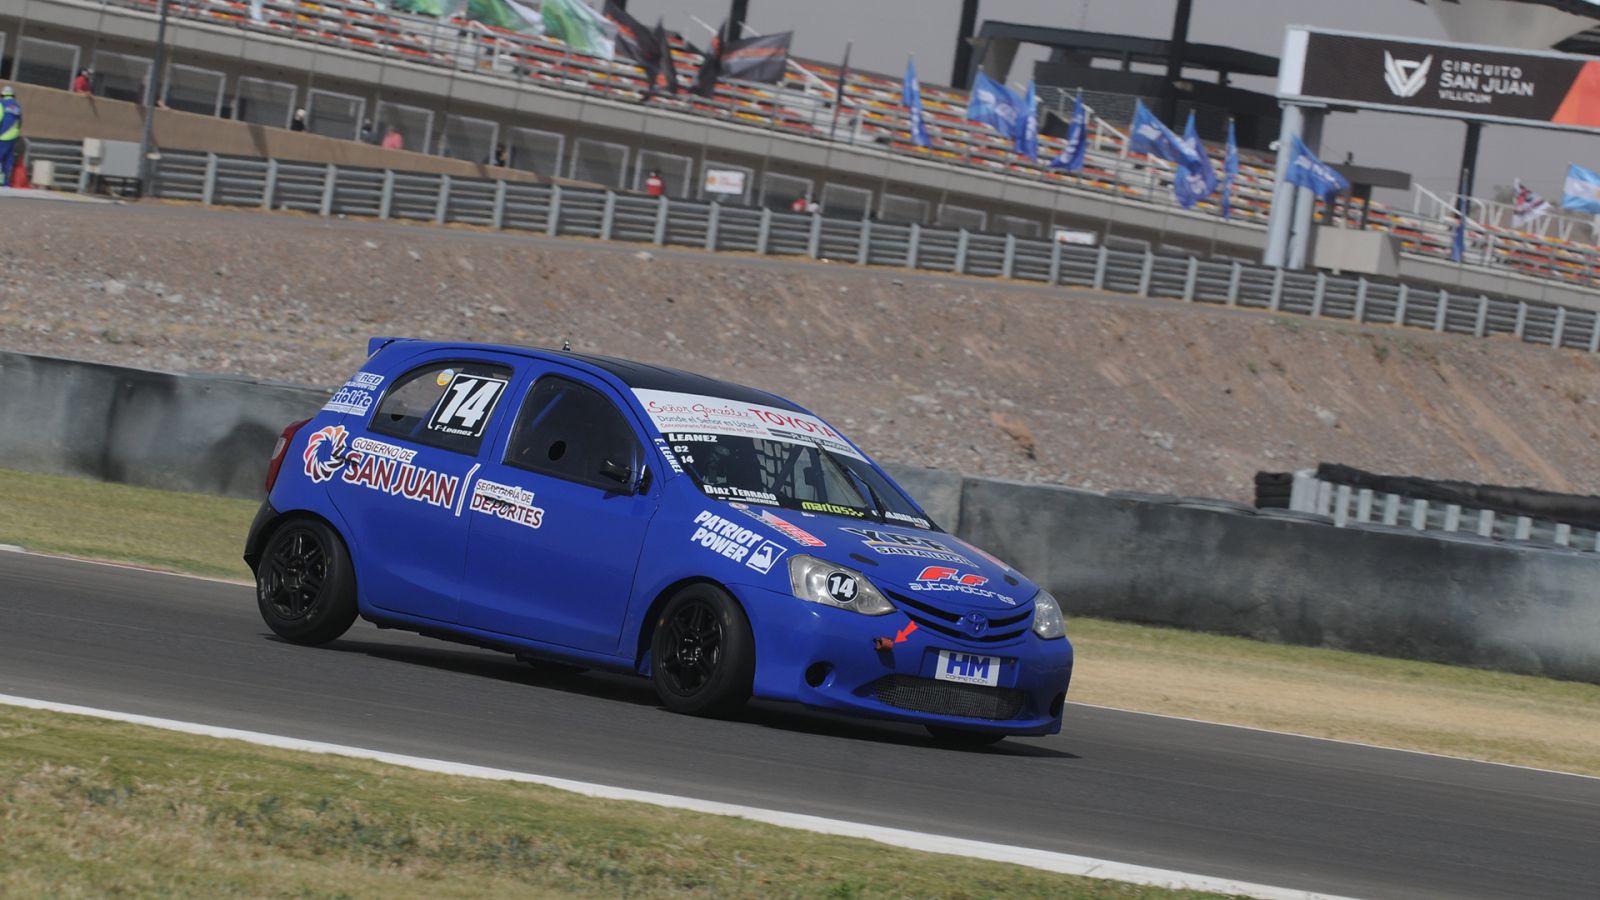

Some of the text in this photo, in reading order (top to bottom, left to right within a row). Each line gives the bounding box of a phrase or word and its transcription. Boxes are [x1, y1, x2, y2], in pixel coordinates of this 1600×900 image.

[1441, 59, 1523, 79] CIRCUITO
[1439, 73, 1535, 97] SAN JUAN
[332, 387, 372, 408] sioLife
[437, 378, 502, 428] 14
[434, 424, 473, 437] F-Leanez
[647, 401, 688, 414] Señor
[747, 407, 843, 442] TOYOTA
[657, 414, 685, 423] Donde
[668, 432, 718, 443] LEANEZ
[673, 445, 690, 453] C2
[352, 438, 415, 462] GOBIERNO DE
[659, 446, 684, 474] LEANEZ
[680, 454, 694, 464] 14
[344, 452, 457, 507] SAN JUAN
[520, 492, 533, 504] DE
[729, 486, 777, 501] TERRADO
[471, 492, 543, 527] DEPORTES
[693, 509, 764, 548] PATRIOT
[690, 526, 750, 563] POWER
[830, 575, 855, 599] 14
[908, 581, 1017, 606] automotores
[946, 652, 991, 679] HM
